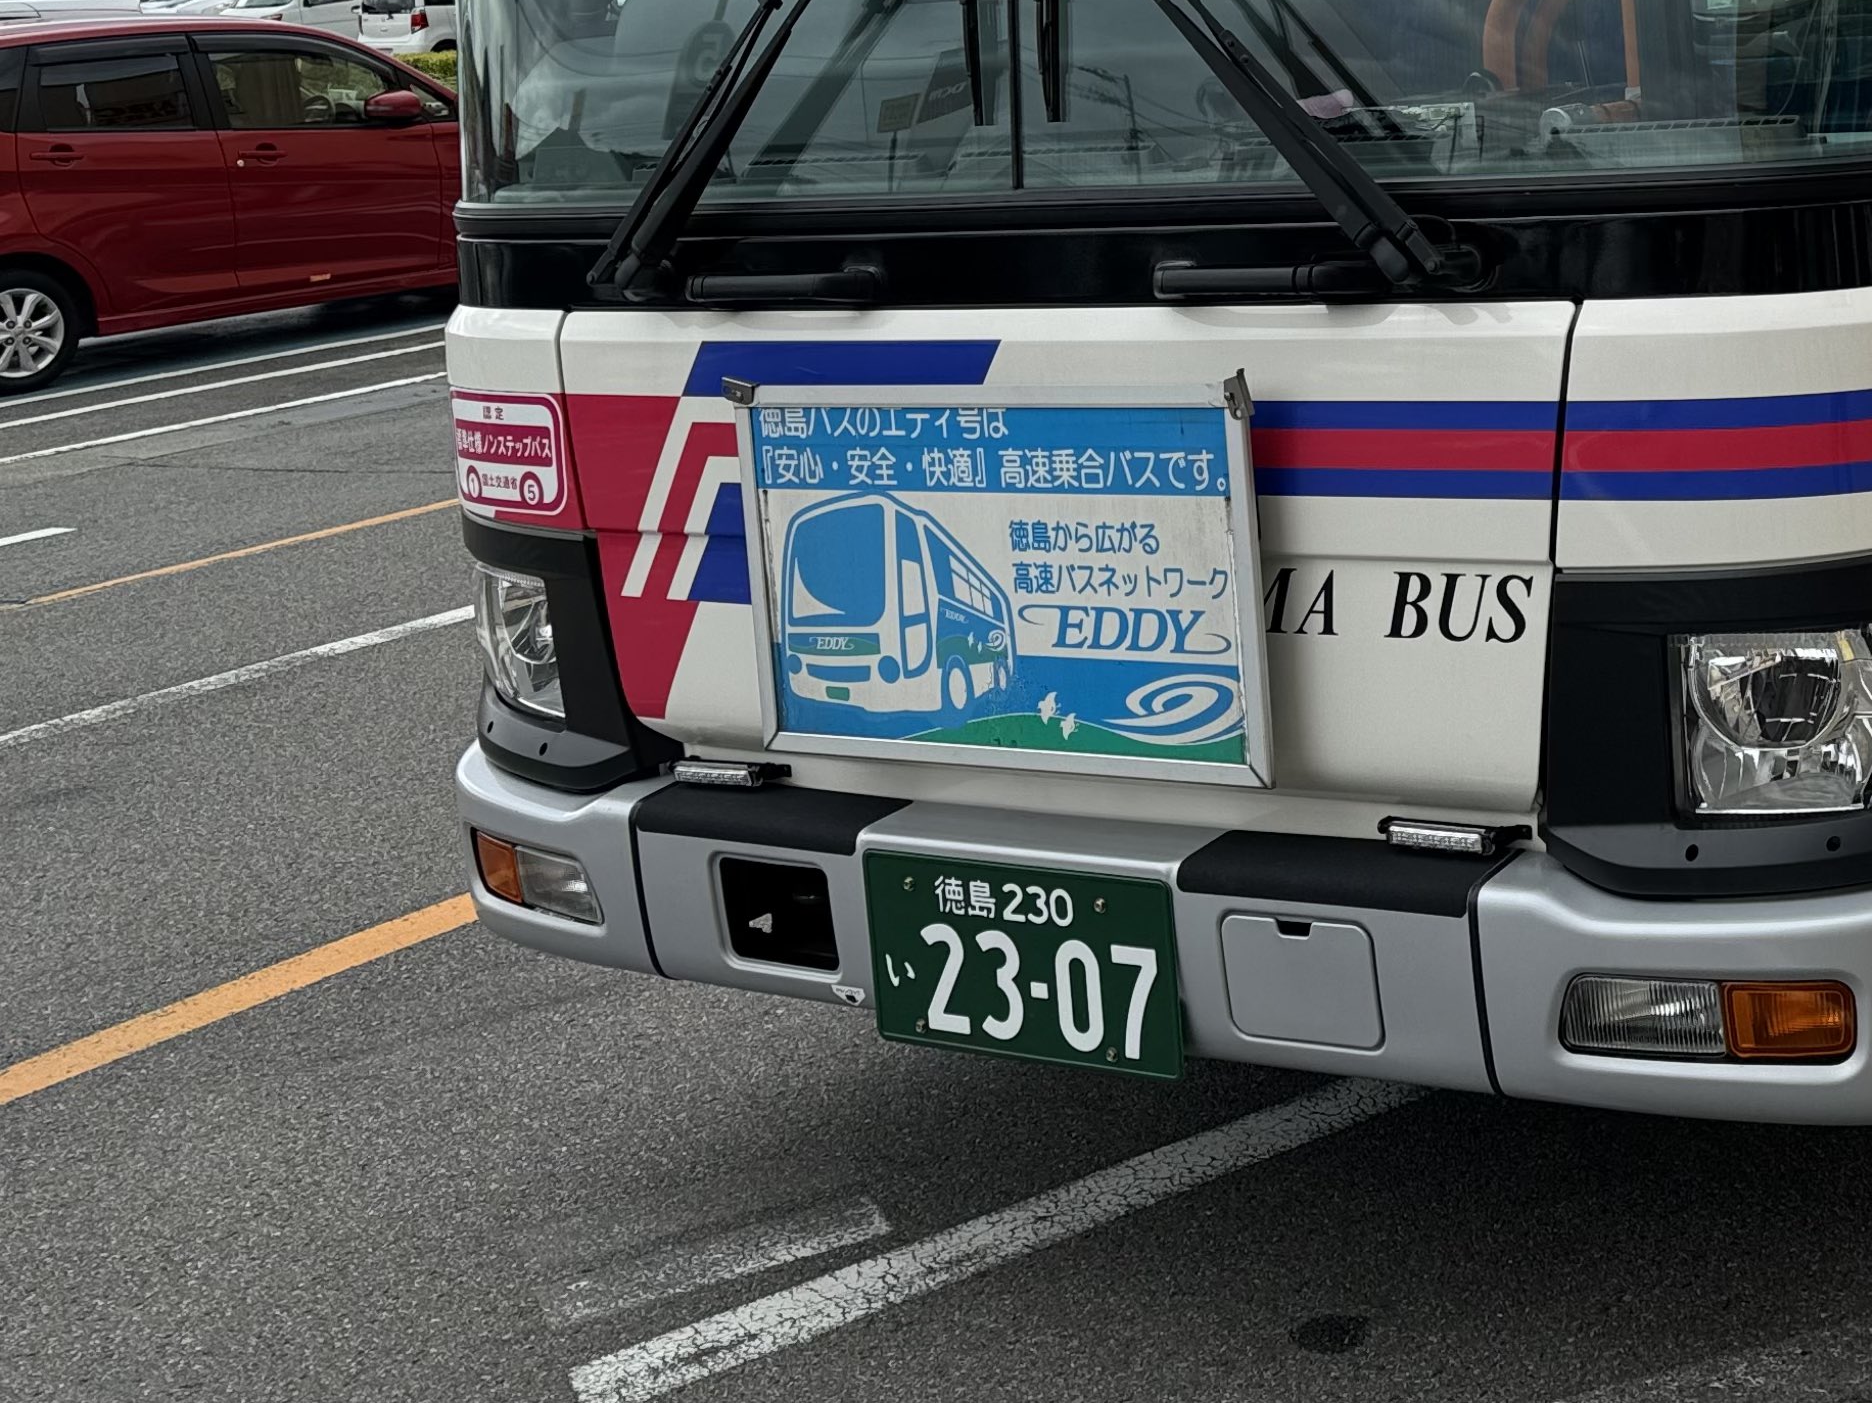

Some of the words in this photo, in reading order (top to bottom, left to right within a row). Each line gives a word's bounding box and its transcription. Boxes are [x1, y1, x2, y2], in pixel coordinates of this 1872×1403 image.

[1008, 519, 1161, 555] 徳島から広がる
[1012, 561, 1229, 600] 高速バスネットワーク
[1026, 604, 1224, 654] EDDY
[1384, 571, 1534, 643] BUS
[811, 636, 853, 650] EDDY
[885, 953, 916, 987] い
[920, 923, 1158, 1060] 23-07
